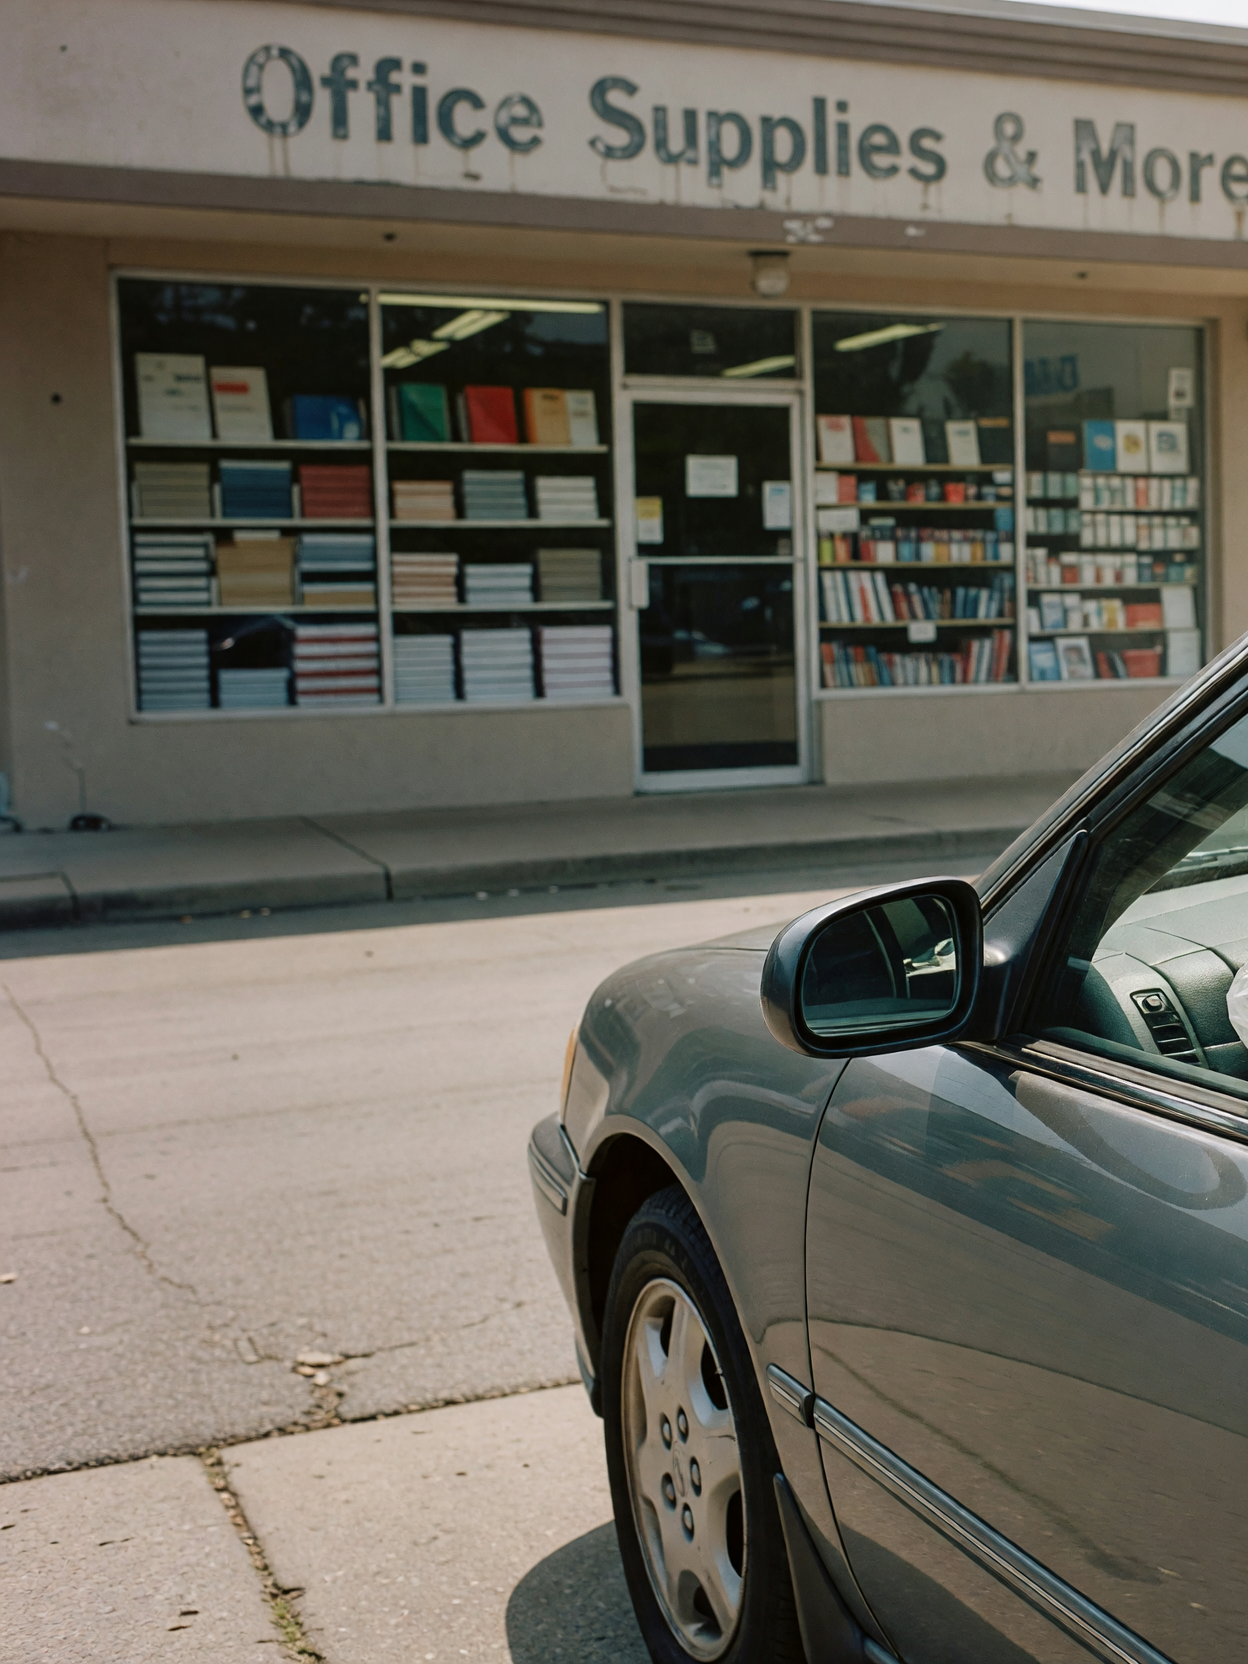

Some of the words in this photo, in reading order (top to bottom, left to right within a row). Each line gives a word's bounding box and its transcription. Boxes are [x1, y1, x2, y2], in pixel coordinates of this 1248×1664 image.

[242, 43, 544, 152] Office
[588, 75, 947, 191] Supplies
[984, 111, 1043, 190] &
